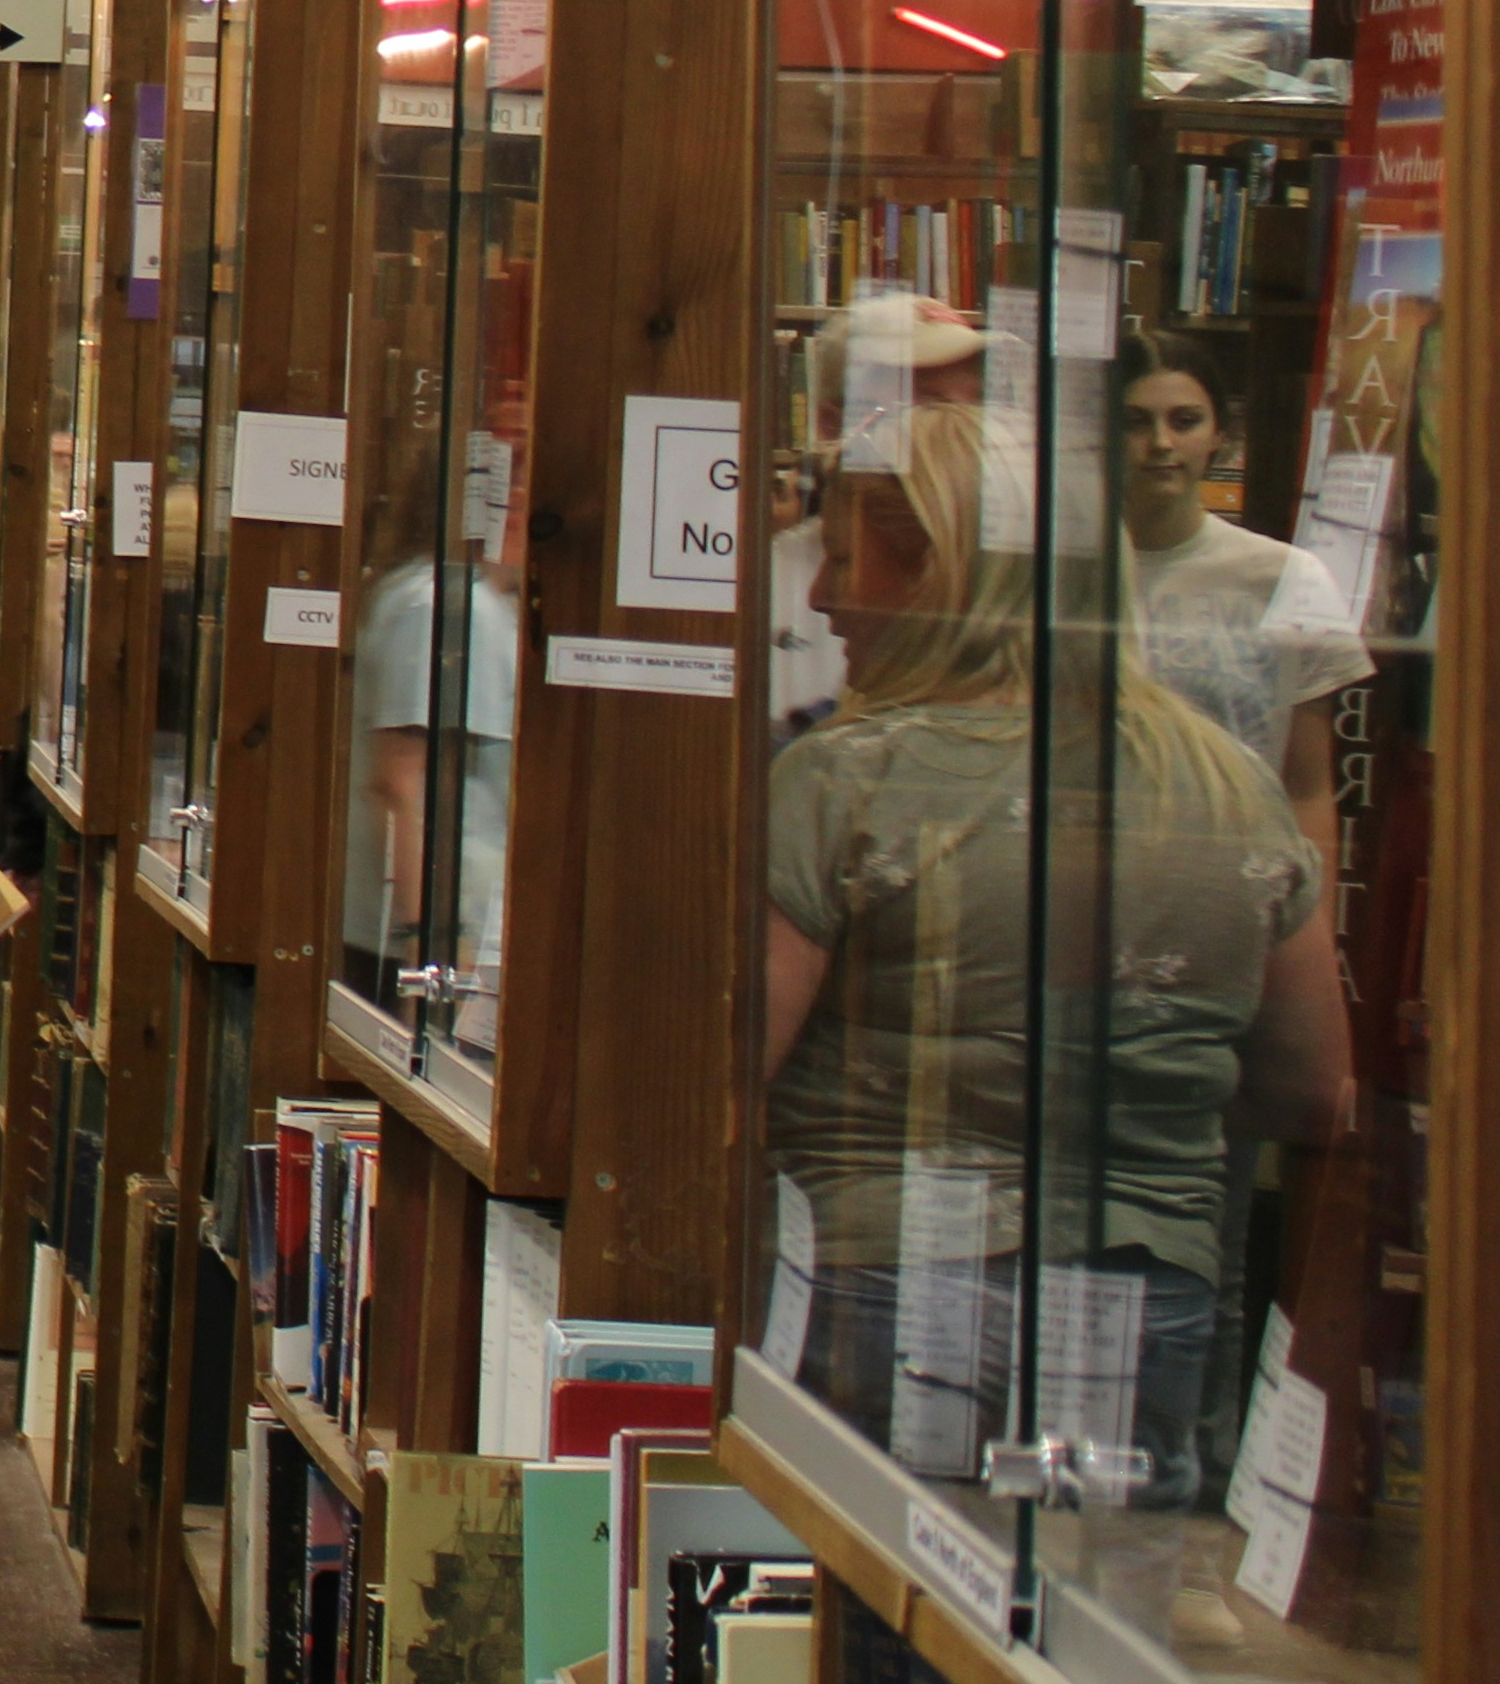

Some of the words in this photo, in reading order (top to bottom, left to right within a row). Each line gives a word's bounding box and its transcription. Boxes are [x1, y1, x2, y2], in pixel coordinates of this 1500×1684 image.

[297, 609, 334, 625] CCTV
[573, 651, 594, 663] SEE
[596, 652, 623, 664] ALSO
[625, 654, 644, 666] THE
[673, 658, 716, 670] SECTION
